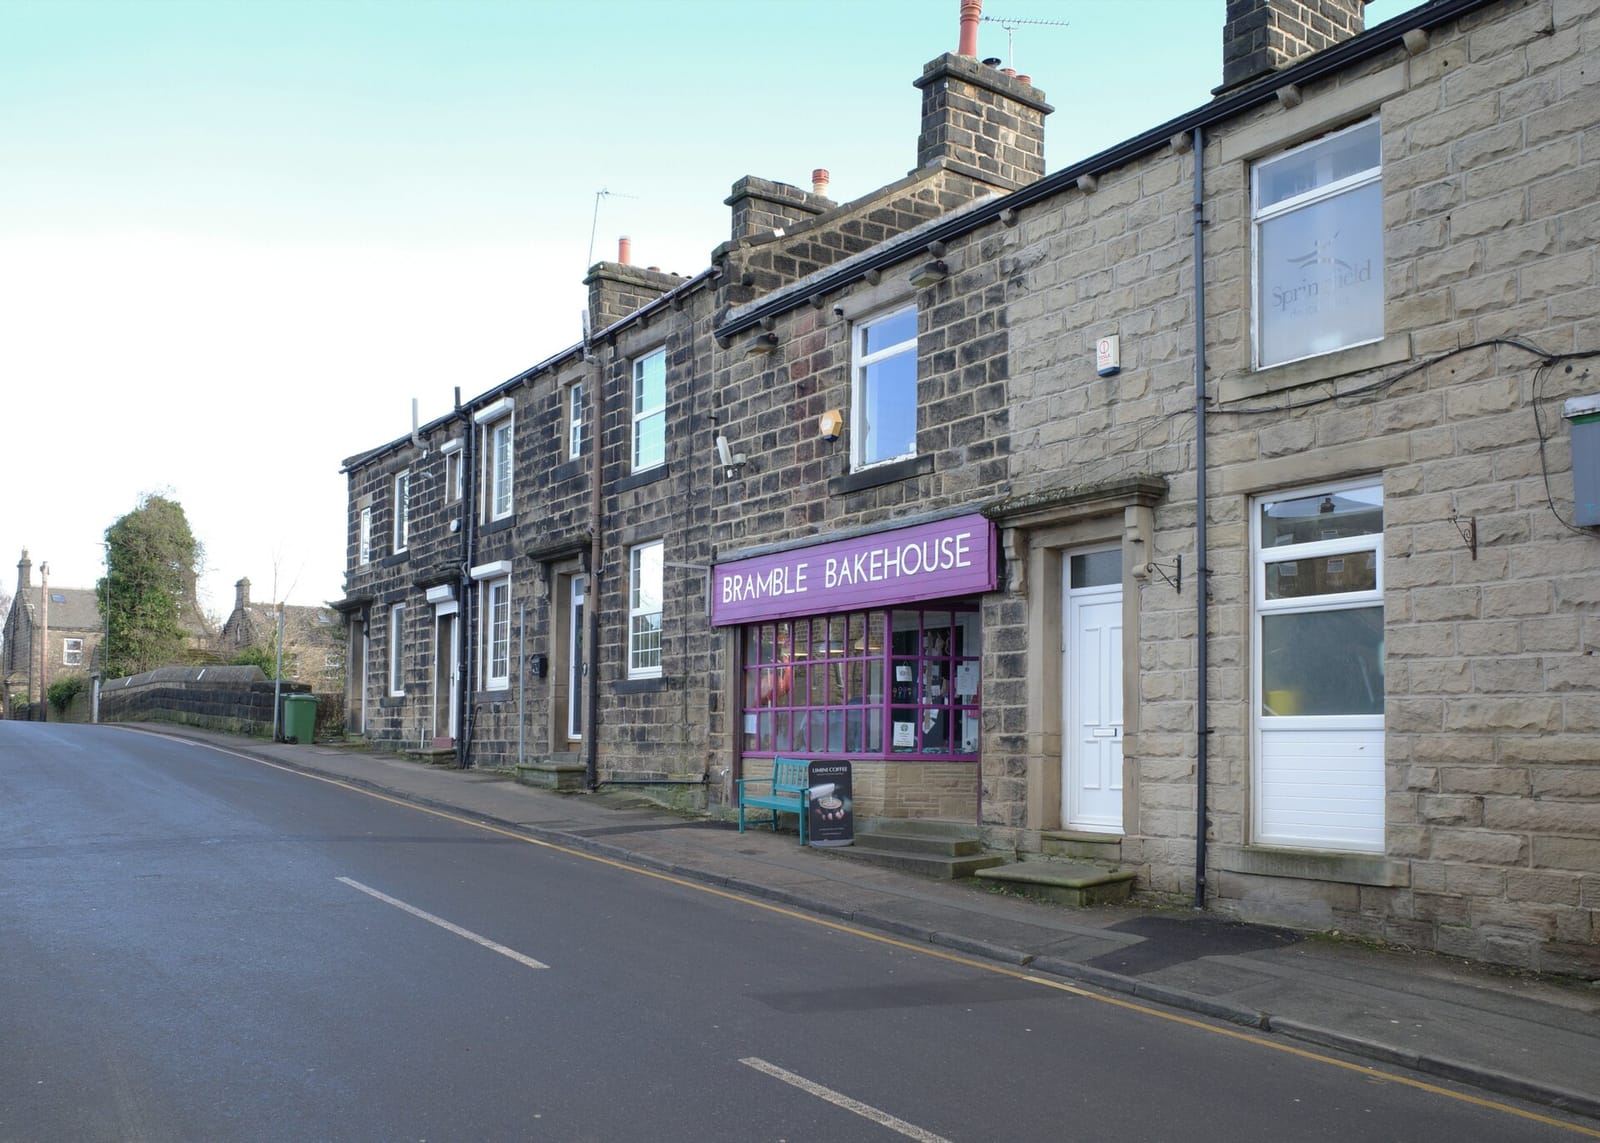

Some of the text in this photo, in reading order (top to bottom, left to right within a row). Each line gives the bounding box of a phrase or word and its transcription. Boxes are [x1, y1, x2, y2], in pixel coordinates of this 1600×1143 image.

[1272, 259, 1371, 311] Sprinield
[722, 532, 971, 604] BRAMBLE BAKEHOUSE
